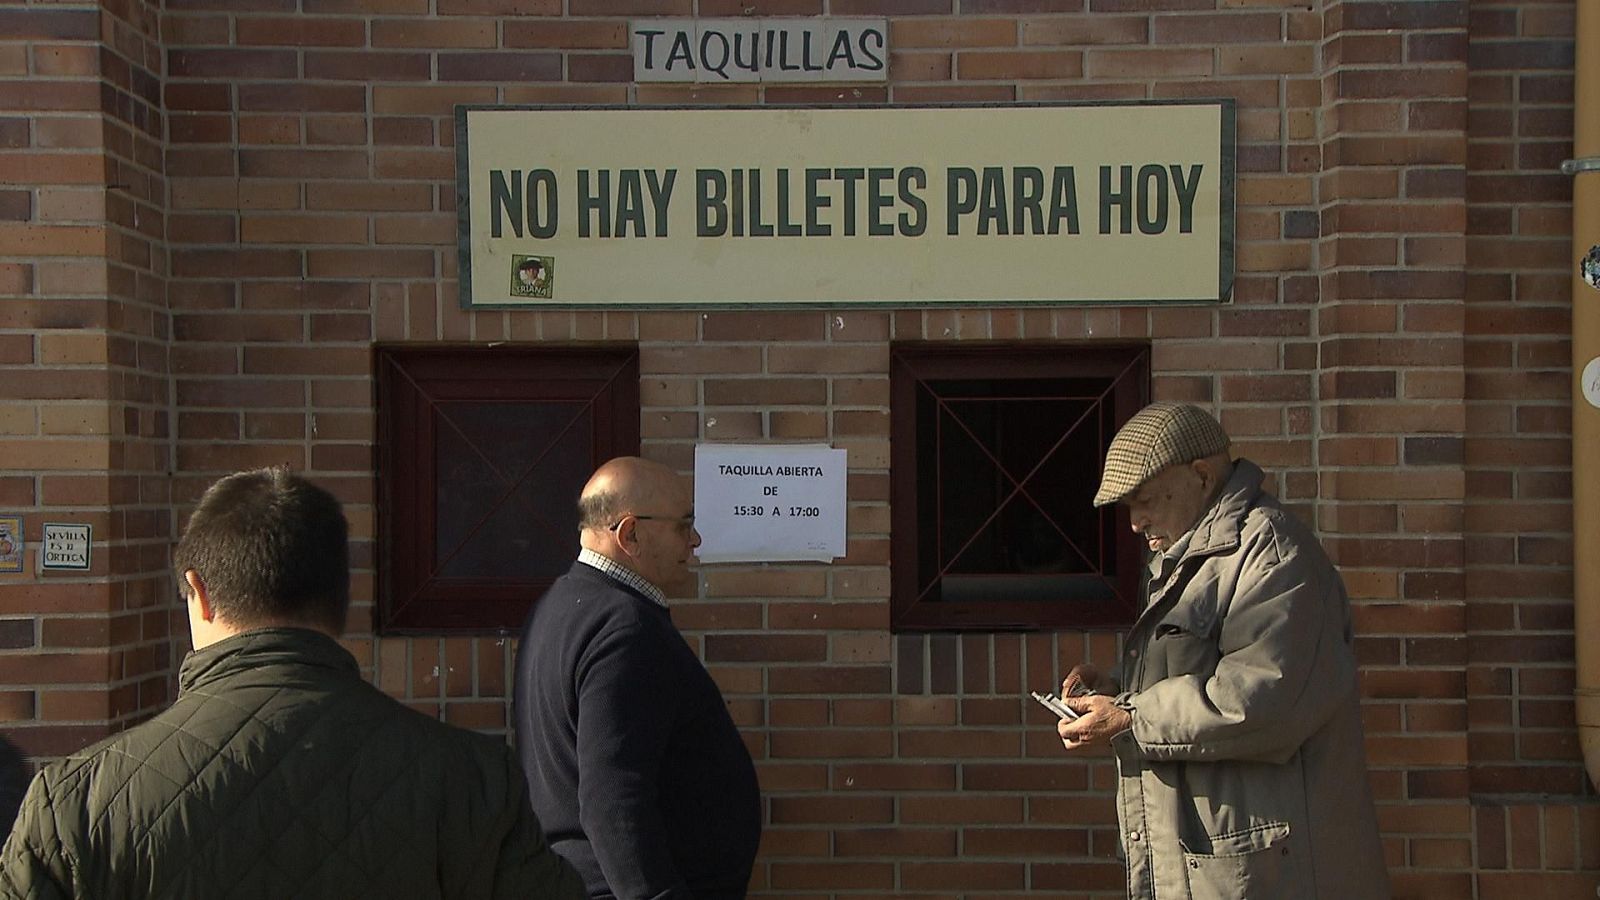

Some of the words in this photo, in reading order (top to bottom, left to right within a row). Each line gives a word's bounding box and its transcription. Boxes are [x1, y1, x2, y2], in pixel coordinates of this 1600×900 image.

[634, 28, 884, 79] TAQUILLAS
[489, 168, 559, 239] NO
[577, 168, 678, 238] HAY
[695, 166, 928, 237] BILLETES
[946, 166, 1080, 236] PARA
[1098, 163, 1204, 235] HOY
[718, 465, 773, 476] TAQUILLA
[776, 466, 823, 477] ABIERTA
[763, 486, 778, 496] DE
[733, 506, 764, 516] 15:30
[771, 506, 781, 516] A
[789, 507, 820, 517] 17:00
[46, 552, 85, 561] ORTEGA
